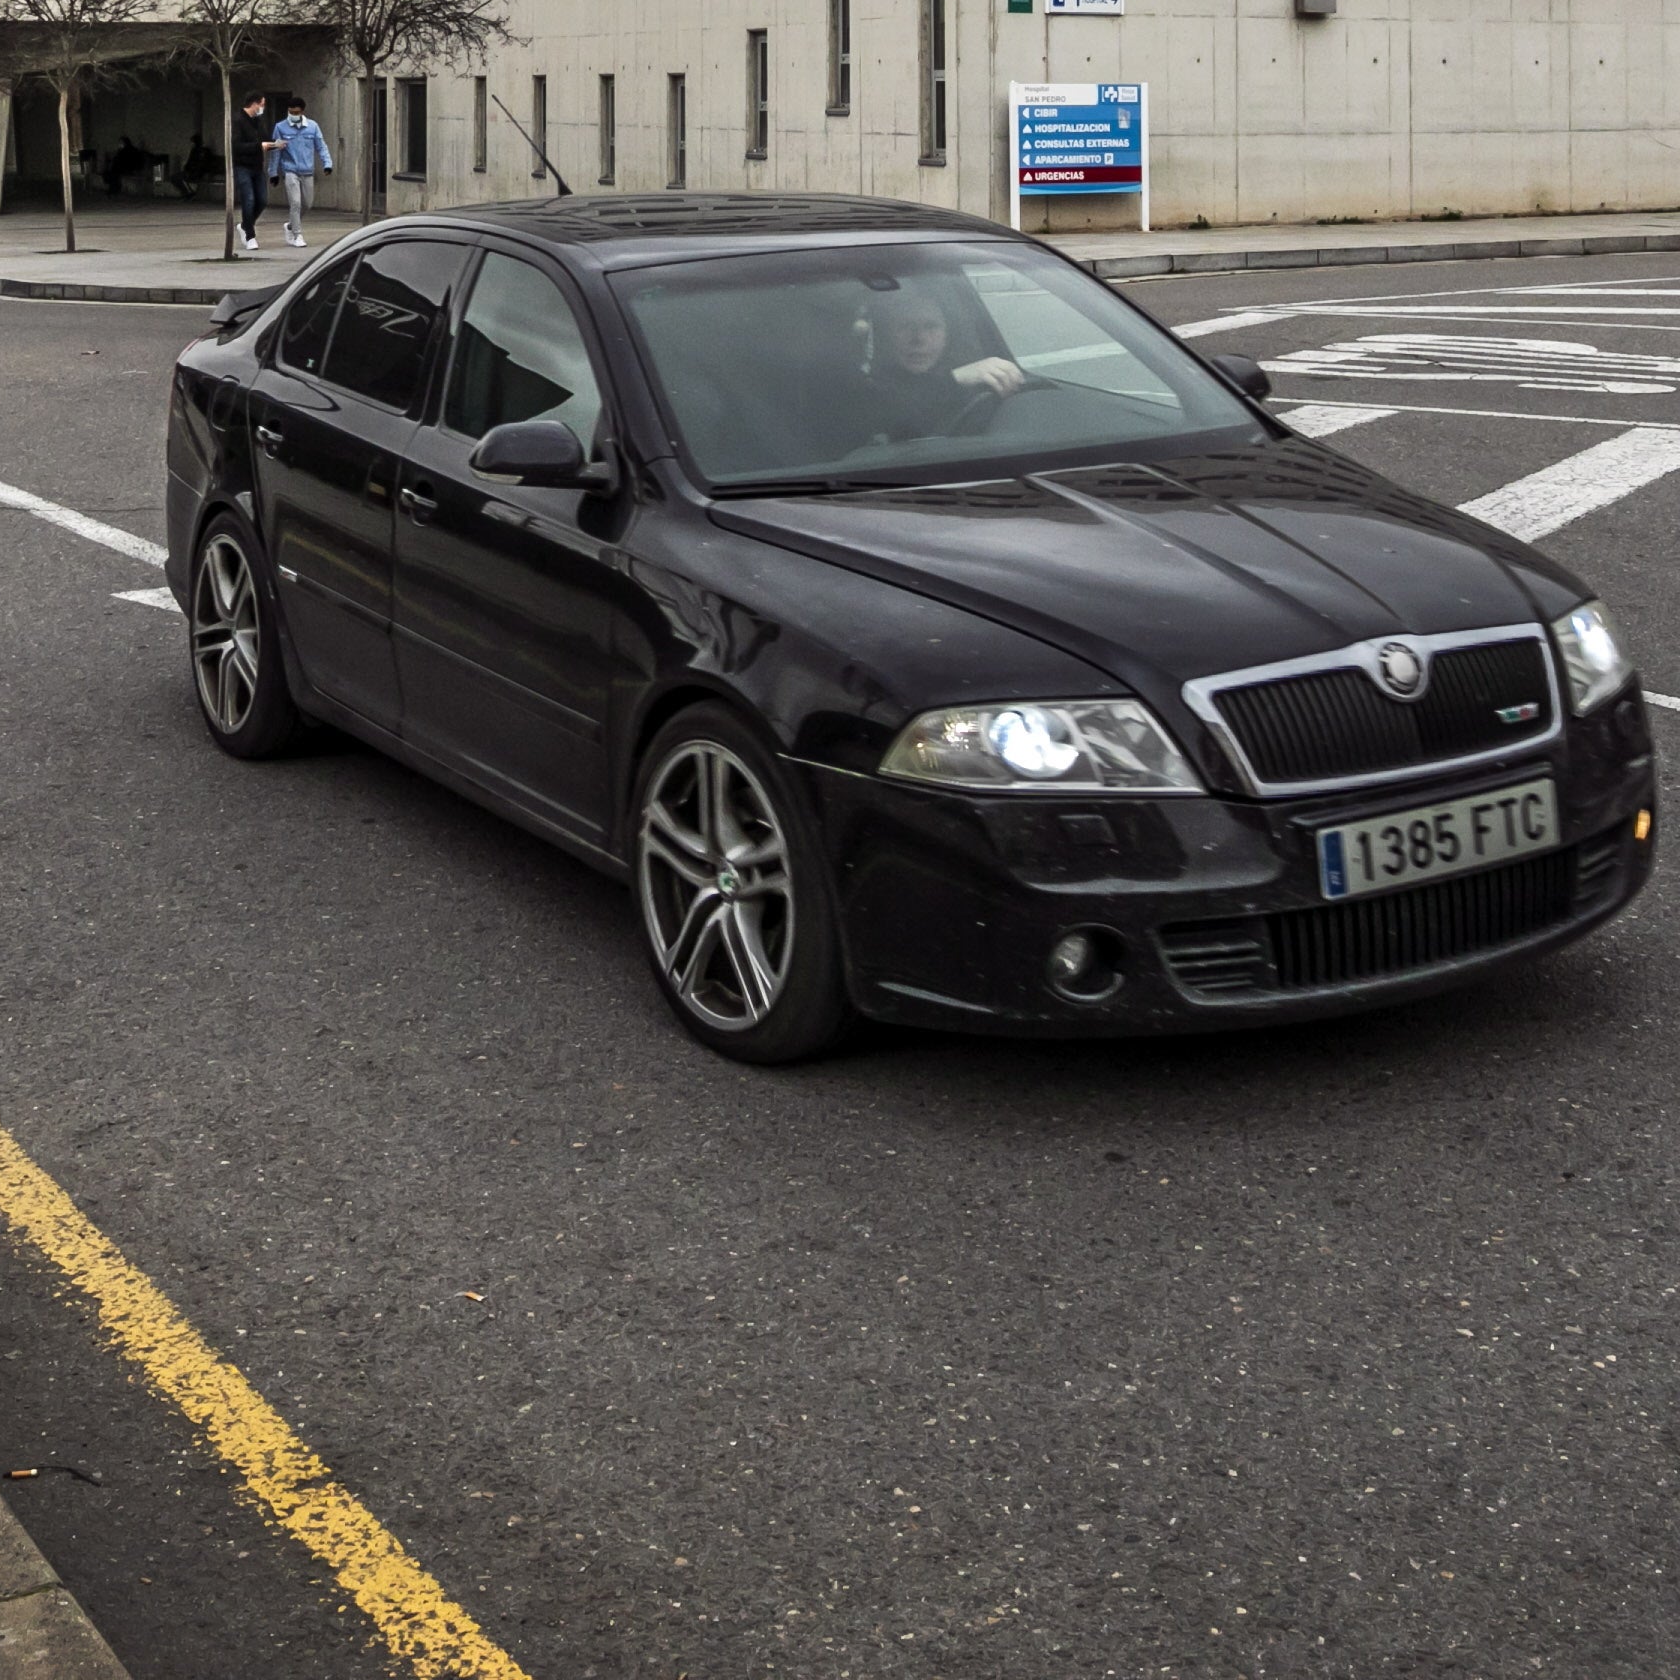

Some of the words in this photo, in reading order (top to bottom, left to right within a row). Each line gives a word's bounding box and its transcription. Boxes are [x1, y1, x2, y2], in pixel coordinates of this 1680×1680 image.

[1034, 108, 1058, 118] CIBIR
[1034, 140, 1085, 148] CONSULTAS
[1086, 139, 1130, 148] EXTERNAS
[1034, 155, 1101, 164] APARCAMIENTO
[1034, 171, 1085, 181] URGENCIAS
[1356, 812, 1462, 882] 1385
[1471, 792, 1547, 856] FTC
